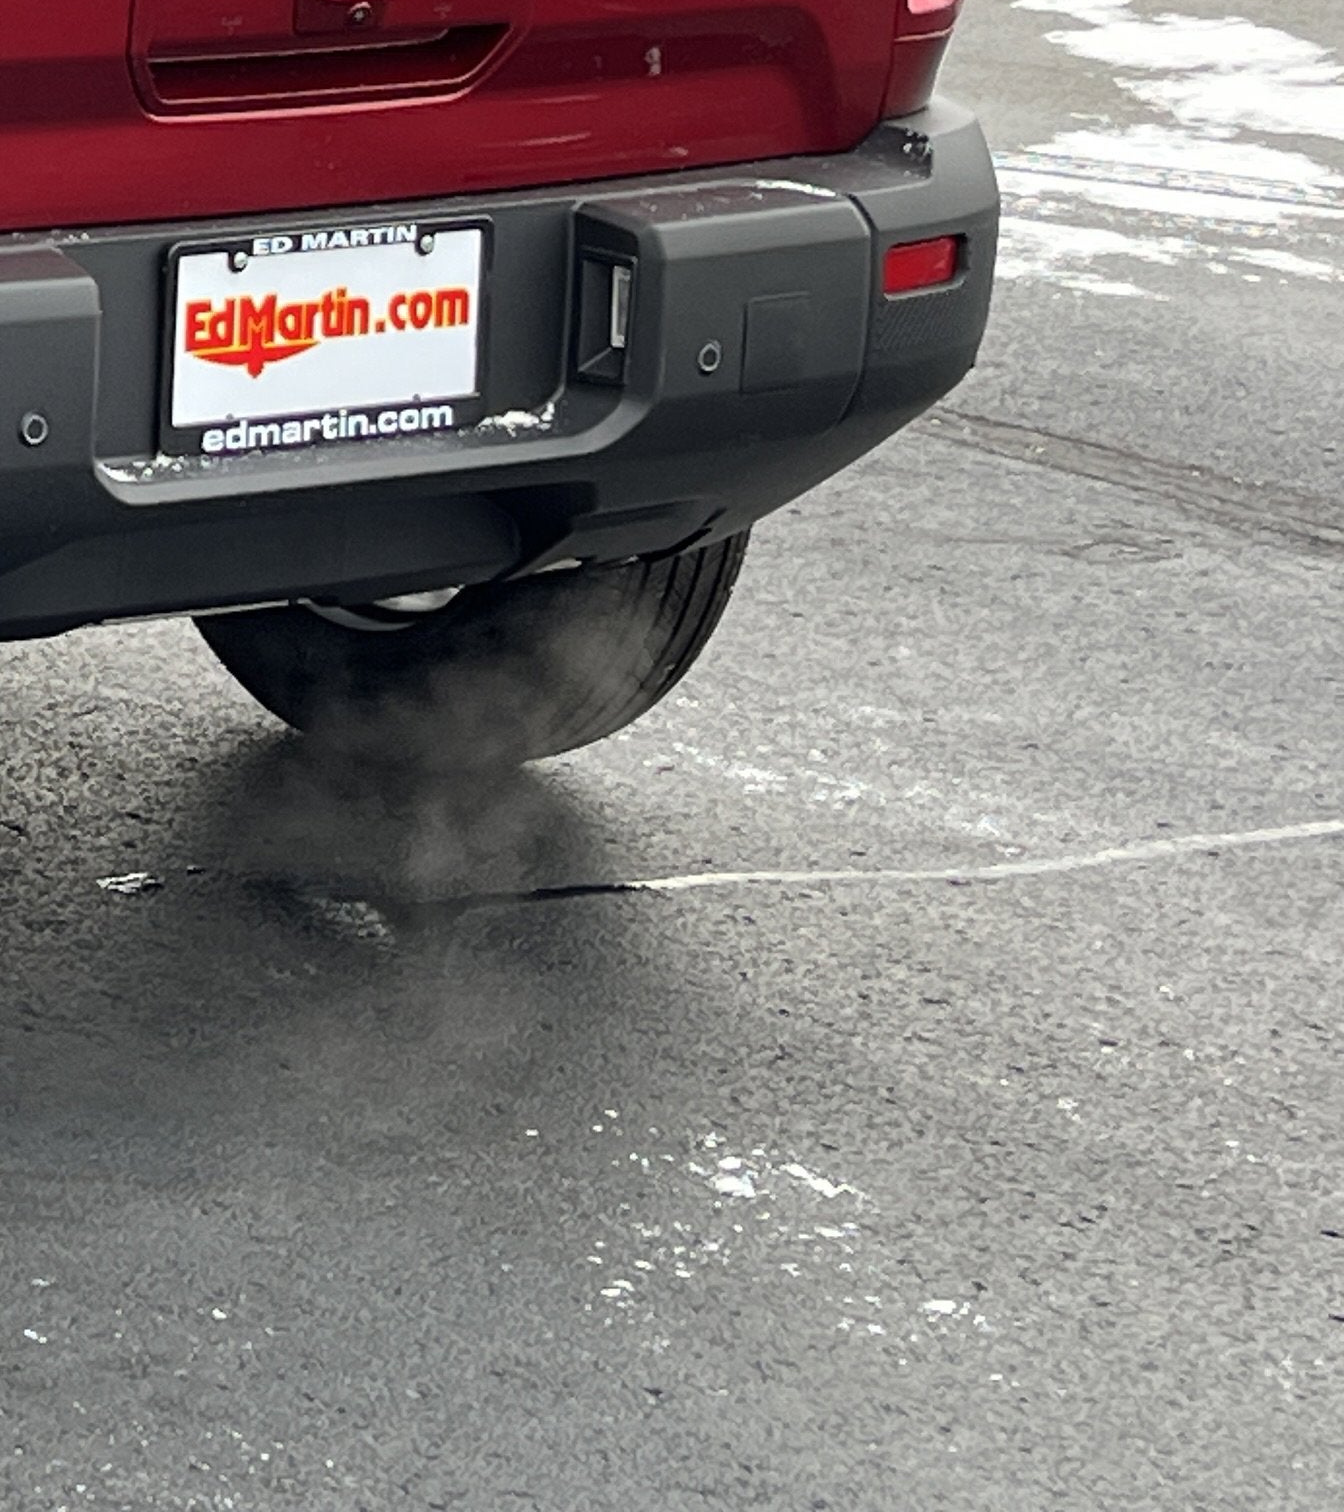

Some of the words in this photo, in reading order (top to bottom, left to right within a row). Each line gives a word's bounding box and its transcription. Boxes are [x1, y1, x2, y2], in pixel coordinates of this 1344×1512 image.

[252, 237, 294, 256] ED
[301, 225, 418, 251] MARTIN
[202, 404, 453, 453] edmartin.com
